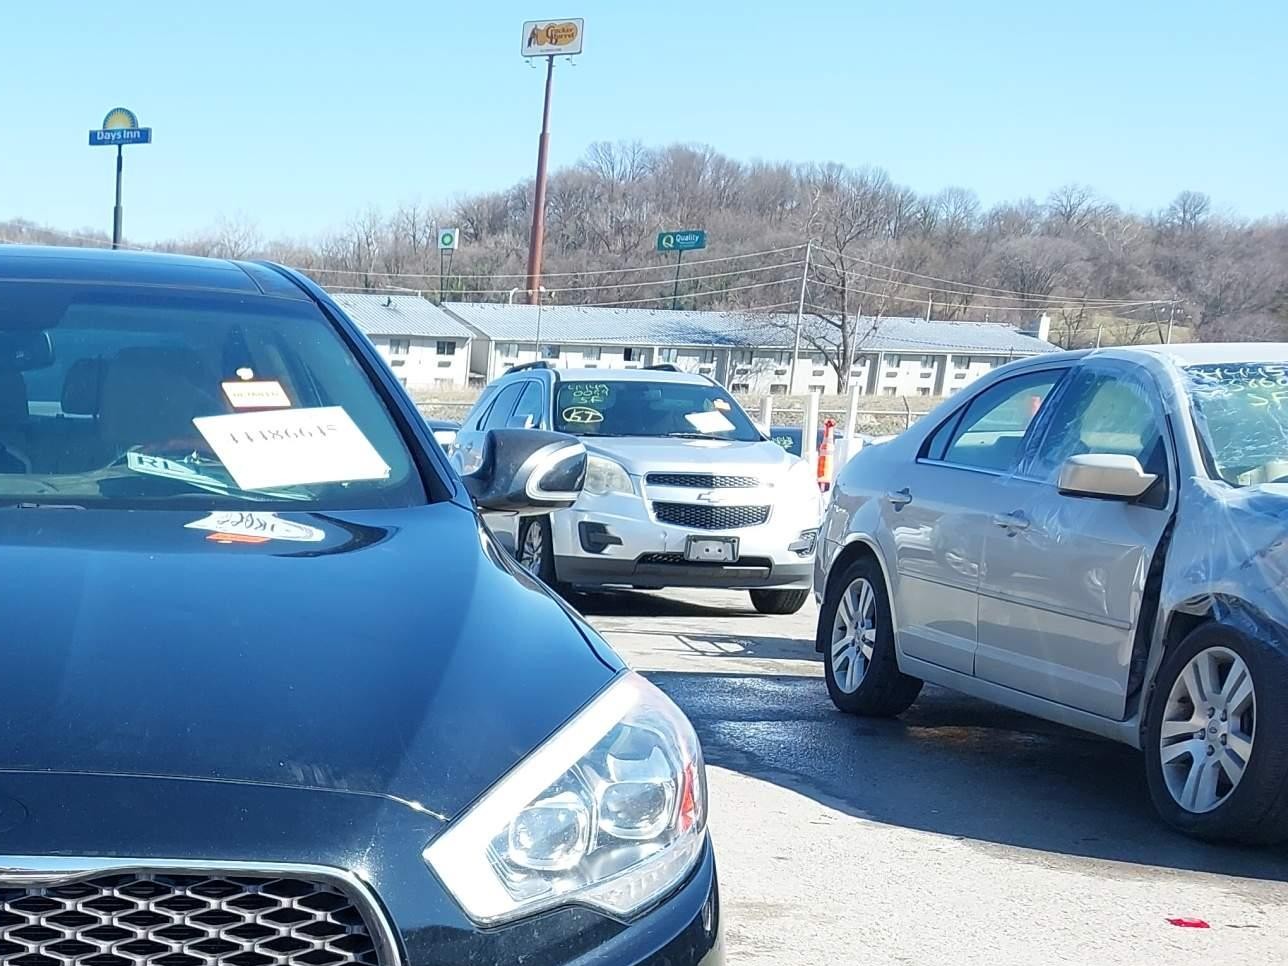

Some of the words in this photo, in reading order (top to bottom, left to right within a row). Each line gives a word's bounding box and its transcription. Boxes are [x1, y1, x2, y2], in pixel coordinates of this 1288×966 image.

[97, 131, 122, 141] Days
[123, 129, 141, 139] Inn
[676, 234, 700, 243] Quality
